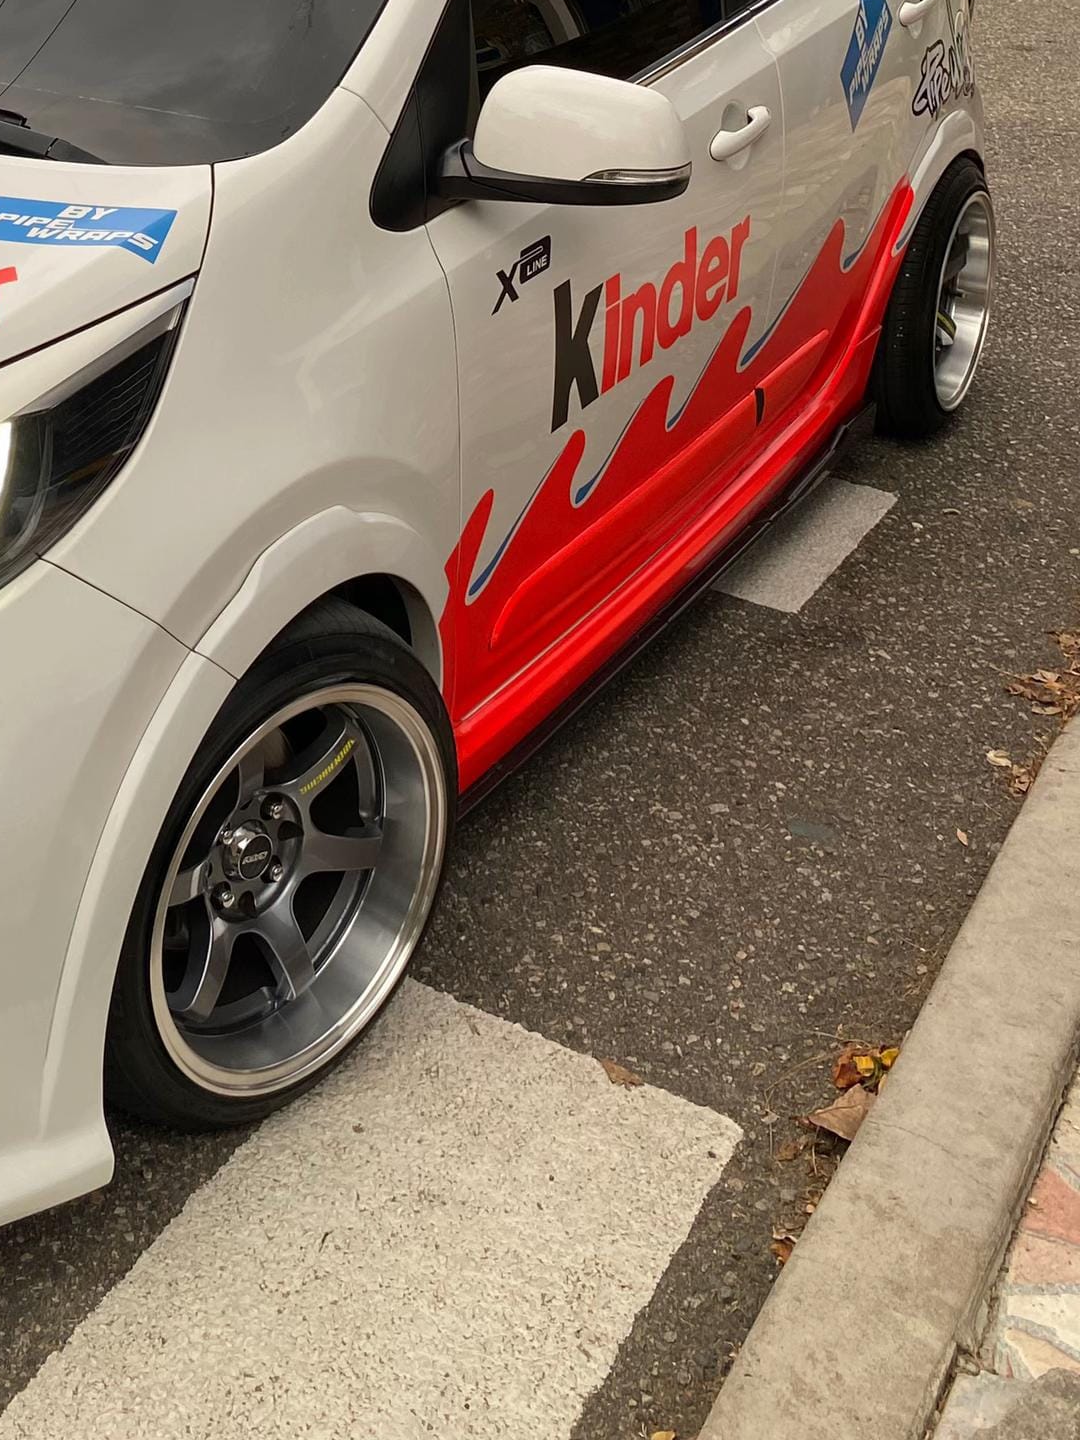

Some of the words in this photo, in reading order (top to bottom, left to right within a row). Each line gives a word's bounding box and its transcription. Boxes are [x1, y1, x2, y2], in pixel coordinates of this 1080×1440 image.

[855, 0, 869, 50] BY
[861, 3, 889, 92] WRAPS
[57, 205, 119, 220] BY
[26, 226, 159, 251] WRAPS
[526, 254, 548, 276] LINE
[551, 215, 751, 434] Kinder
